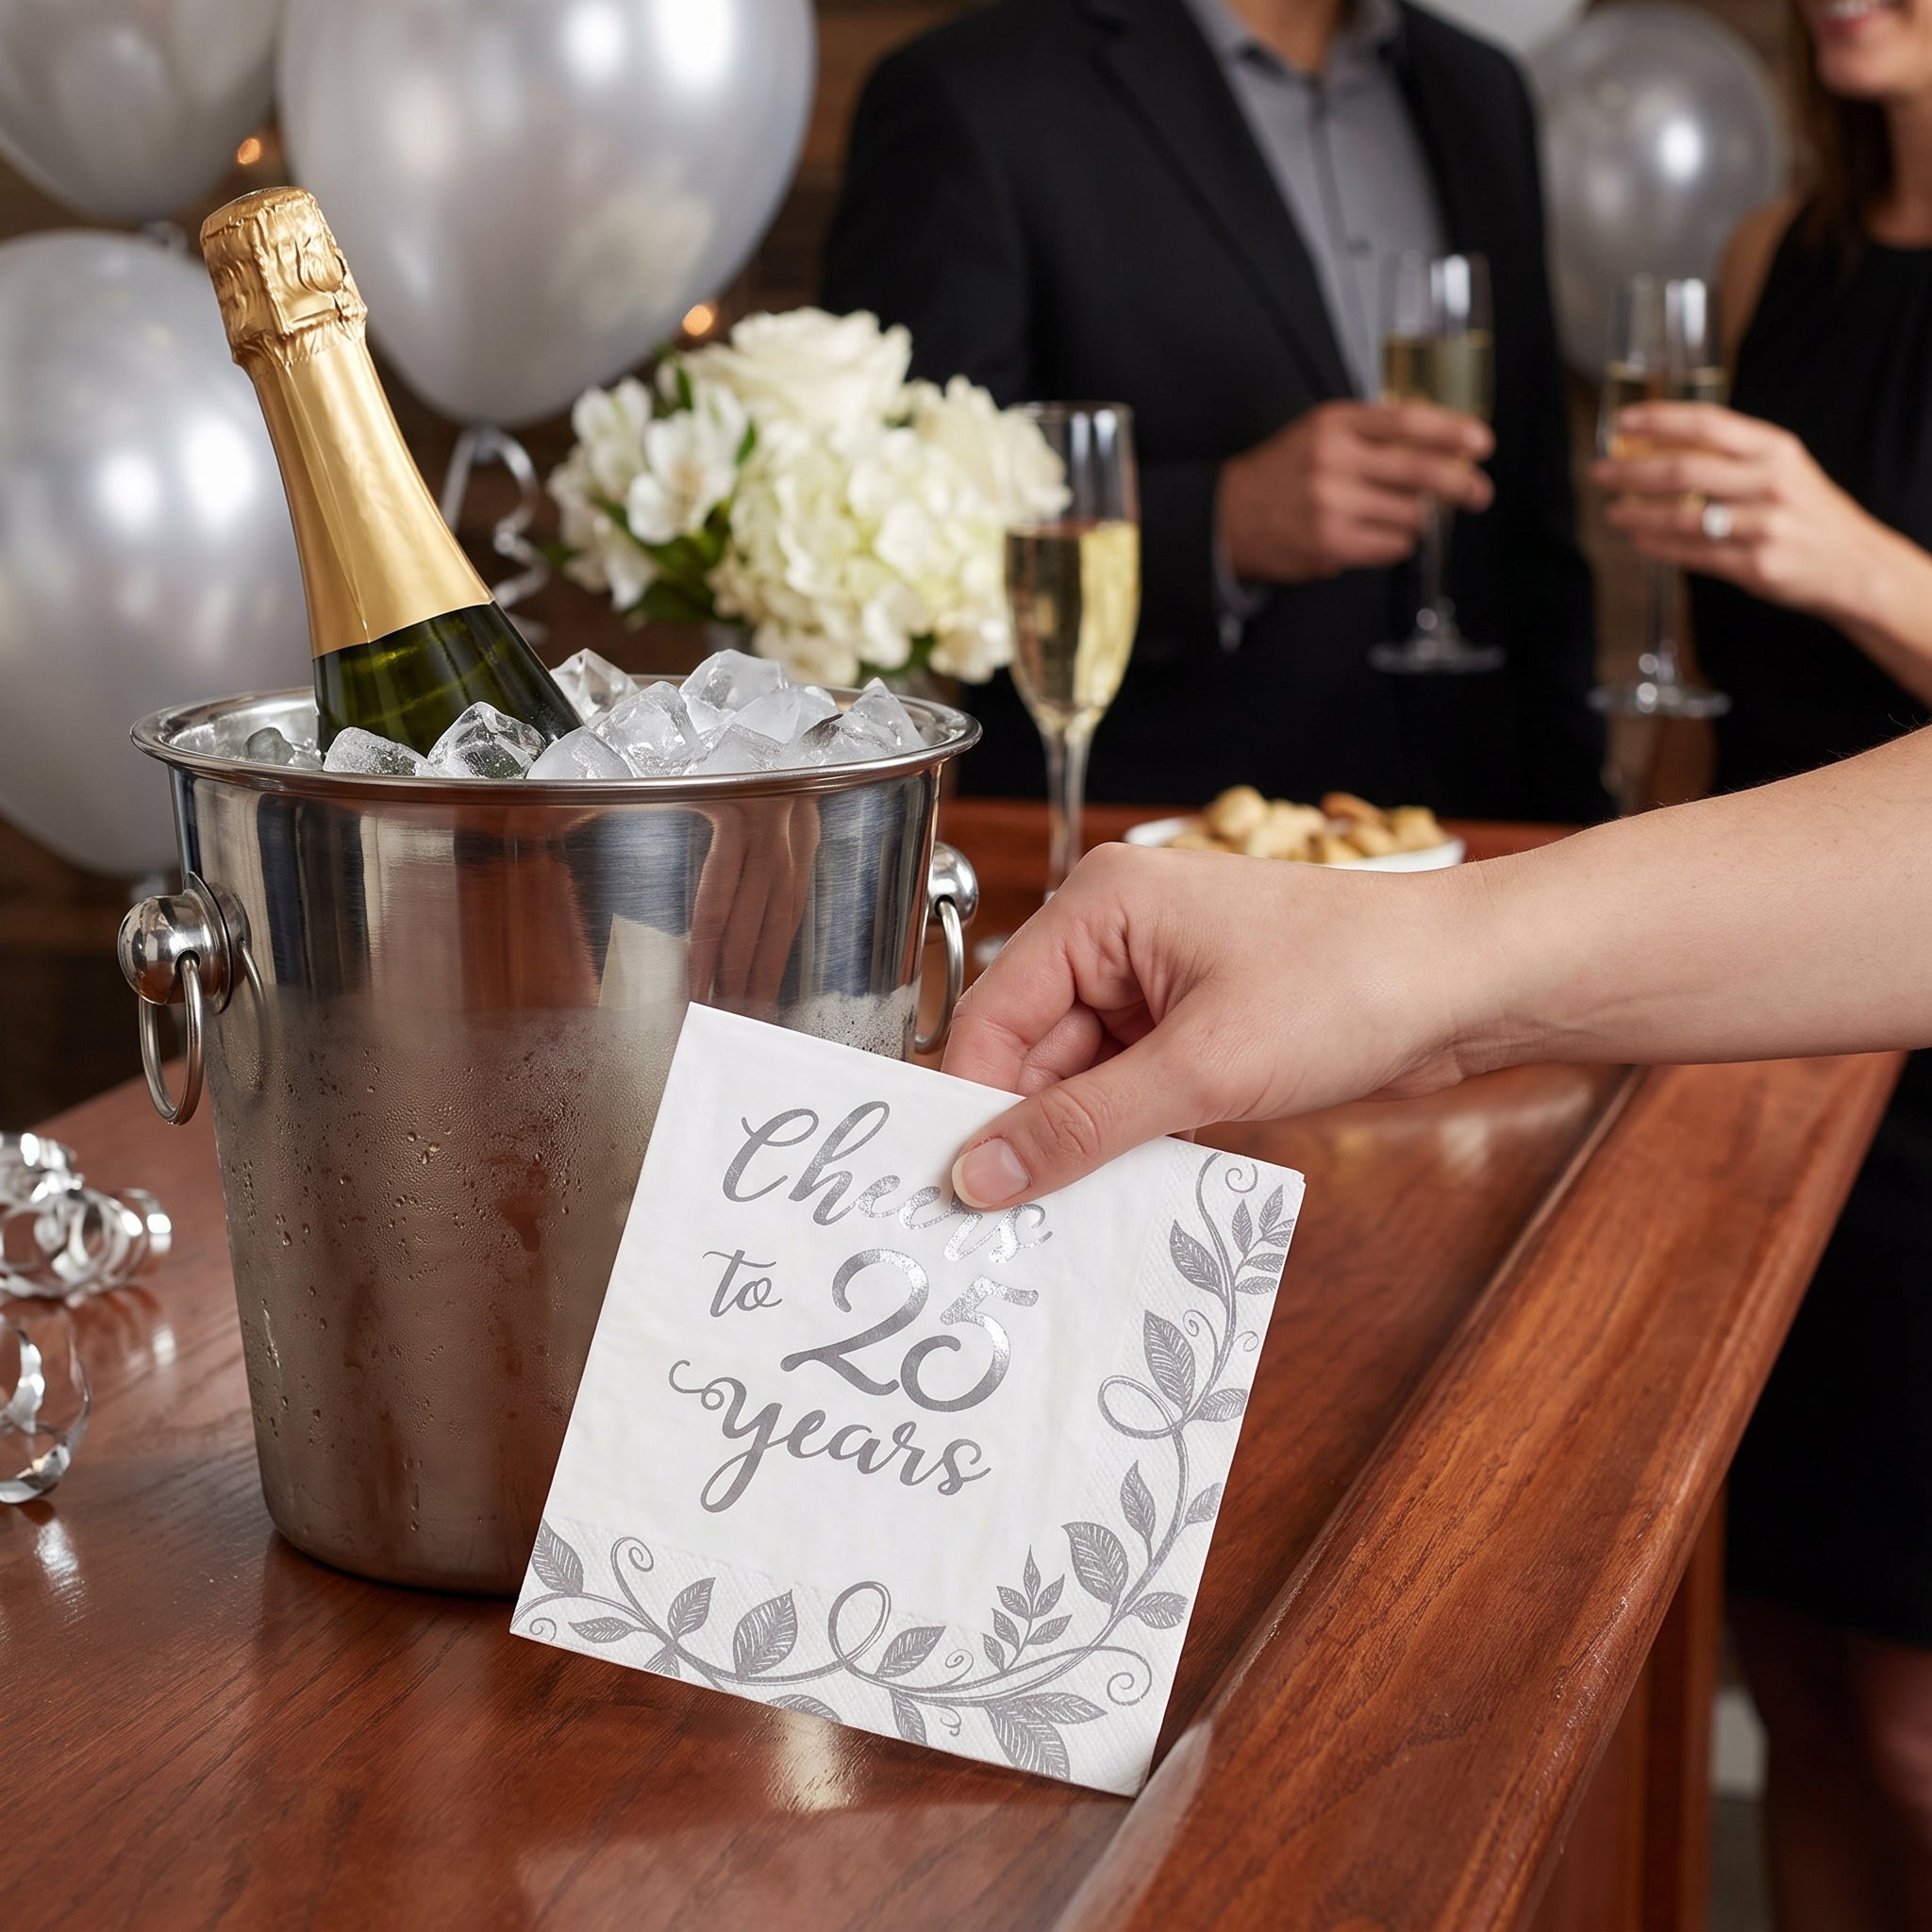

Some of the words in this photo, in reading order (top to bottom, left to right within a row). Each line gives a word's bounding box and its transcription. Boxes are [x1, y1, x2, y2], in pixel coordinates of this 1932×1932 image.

[722, 1100, 1053, 1264] Cheers
[703, 1249, 782, 1318] to
[780, 1248, 1040, 1413] 25
[668, 1360, 992, 1514] years
